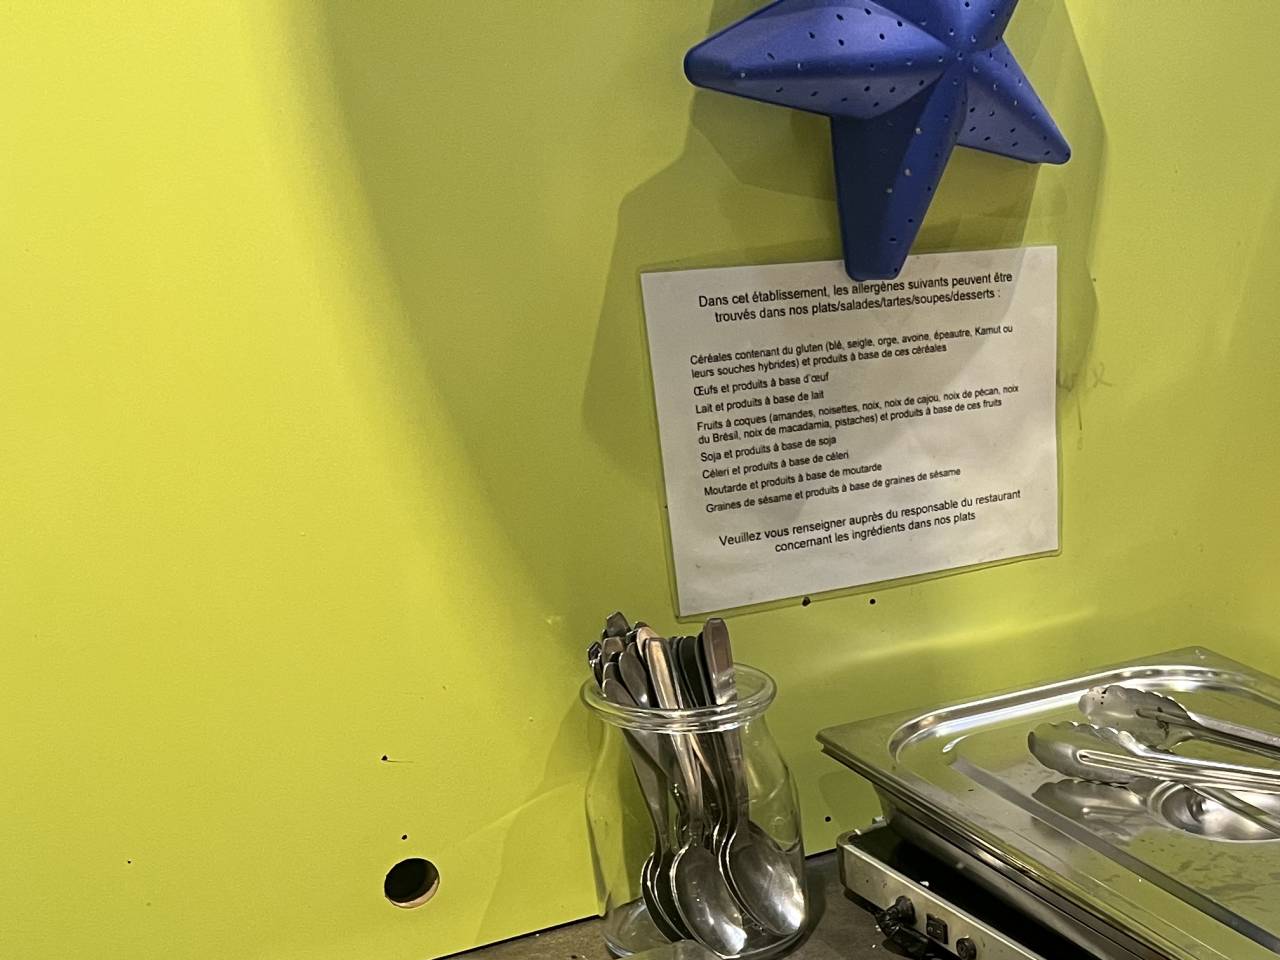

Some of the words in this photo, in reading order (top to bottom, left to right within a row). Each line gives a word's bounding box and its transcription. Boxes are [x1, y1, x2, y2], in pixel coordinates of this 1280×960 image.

[698, 295, 729, 308] Dans
[731, 292, 750, 305] cet
[833, 284, 849, 296] les
[851, 280, 905, 295] allergènes
[907, 276, 949, 290] suivants
[951, 272, 992, 289] peuvent
[993, 271, 1013, 283] être
[714, 307, 757, 323] trouvés
[758, 306, 786, 319] dans
[788, 305, 809, 316] nos
[689, 352, 733, 365] Céréales
[734, 346, 780, 360] contenant
[781, 345, 794, 355] du
[795, 343, 824, 357] gluten
[974, 325, 1002, 336] Kamut
[1002, 325, 1013, 333] ou
[690, 368, 715, 379] leurs
[716, 363, 756, 376] souches
[757, 355, 800, 373] hybrides)
[801, 356, 811, 366] et
[812, 353, 848, 368] produits
[849, 351, 856, 362] à
[857, 350, 880, 360] base
[881, 348, 893, 358] de
[894, 348, 910, 357] ces
[911, 343, 947, 355] céréales
[695, 403, 714, 414] Lait
[714, 401, 724, 412] et
[726, 397, 763, 413] produits
[764, 395, 771, 406] à
[772, 394, 795, 405] base
[797, 391, 809, 402] de
[810, 389, 824, 400] lait
[720, 383, 730, 393] et
[731, 378, 768, 394] produits
[770, 377, 777, 387] à
[778, 376, 801, 387] base
[696, 420, 724, 432] Fruits
[725, 418, 732, 428] à
[733, 415, 767, 427] coques
[884, 398, 902, 408] noix
[903, 396, 915, 406] de
[943, 392, 961, 400] noix
[961, 389, 973, 399] de
[1002, 384, 1019, 394] noix
[697, 434, 710, 445] du
[743, 427, 763, 438] noix
[764, 425, 776, 436] de
[834, 412, 878, 430] pistaches)
[879, 411, 889, 421] et
[889, 407, 924, 422] produits
[925, 406, 931, 416] à
[932, 405, 953, 415] base
[954, 402, 965, 412] de
[966, 401, 982, 410] ces
[982, 398, 1002, 408] fruits
[700, 451, 722, 463] Soja
[723, 448, 733, 459] et
[734, 444, 772, 459] produits
[772, 442, 780, 452] à
[780, 441, 803, 451] base
[804, 437, 817, 448] de
[818, 435, 837, 447] soja
[701, 466, 730, 479] Céleri
[731, 465, 741, 475] et
[742, 460, 779, 476] produits
[780, 459, 787, 468] à
[788, 457, 811, 467] base
[811, 453, 824, 464] de
[825, 449, 850, 462] céleri
[703, 482, 748, 496] Moutarde
[749, 479, 759, 490] et
[760, 475, 796, 490] produits
[797, 472, 804, 483] à
[805, 471, 827, 481] base
[828, 468, 840, 478] de
[841, 462, 882, 476] moutarde
[705, 500, 742, 513] Graines
[743, 497, 756, 507] de
[757, 493, 793, 505] sésame
[794, 489, 804, 500] et
[804, 485, 840, 500] produits
[841, 483, 847, 493] à
[848, 481, 870, 492] base
[871, 479, 883, 488] de
[884, 475, 916, 488] graines
[916, 471, 927, 481] de
[929, 468, 961, 480] sésame
[718, 531, 762, 546] Veuillez
[763, 527, 790, 539] vous
[792, 518, 847, 535] renseigner
[848, 511, 884, 526] auprès
[885, 508, 898, 520] du
[900, 499, 959, 517] responsable
[960, 496, 973, 508] du
[975, 489, 1021, 505] restaurant
[774, 533, 833, 553] concernant
[834, 532, 850, 542] les
[851, 522, 906, 541] ingrédients
[907, 519, 932, 531] dans
[933, 515, 951, 526] nos
[953, 511, 976, 525] plats
